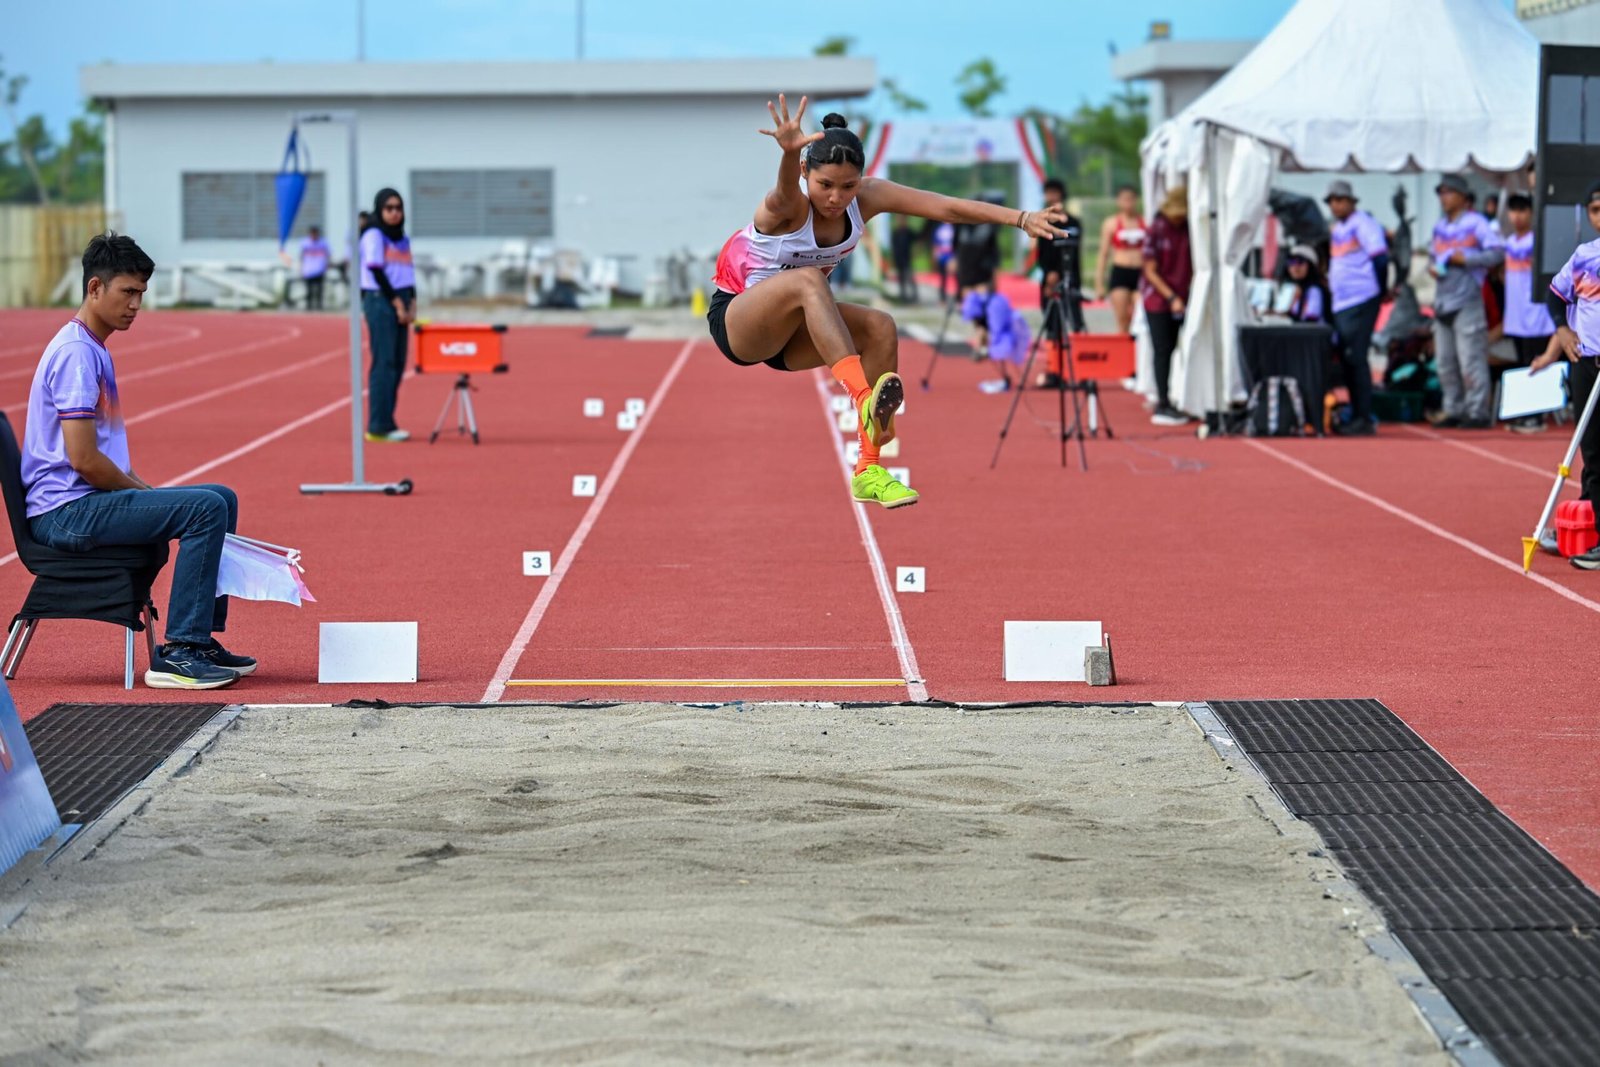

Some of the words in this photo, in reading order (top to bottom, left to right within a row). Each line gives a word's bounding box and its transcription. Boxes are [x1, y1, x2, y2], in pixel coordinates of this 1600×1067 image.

[581, 481, 588, 490] 7
[532, 557, 542, 568] 3
[904, 572, 916, 584] 4
